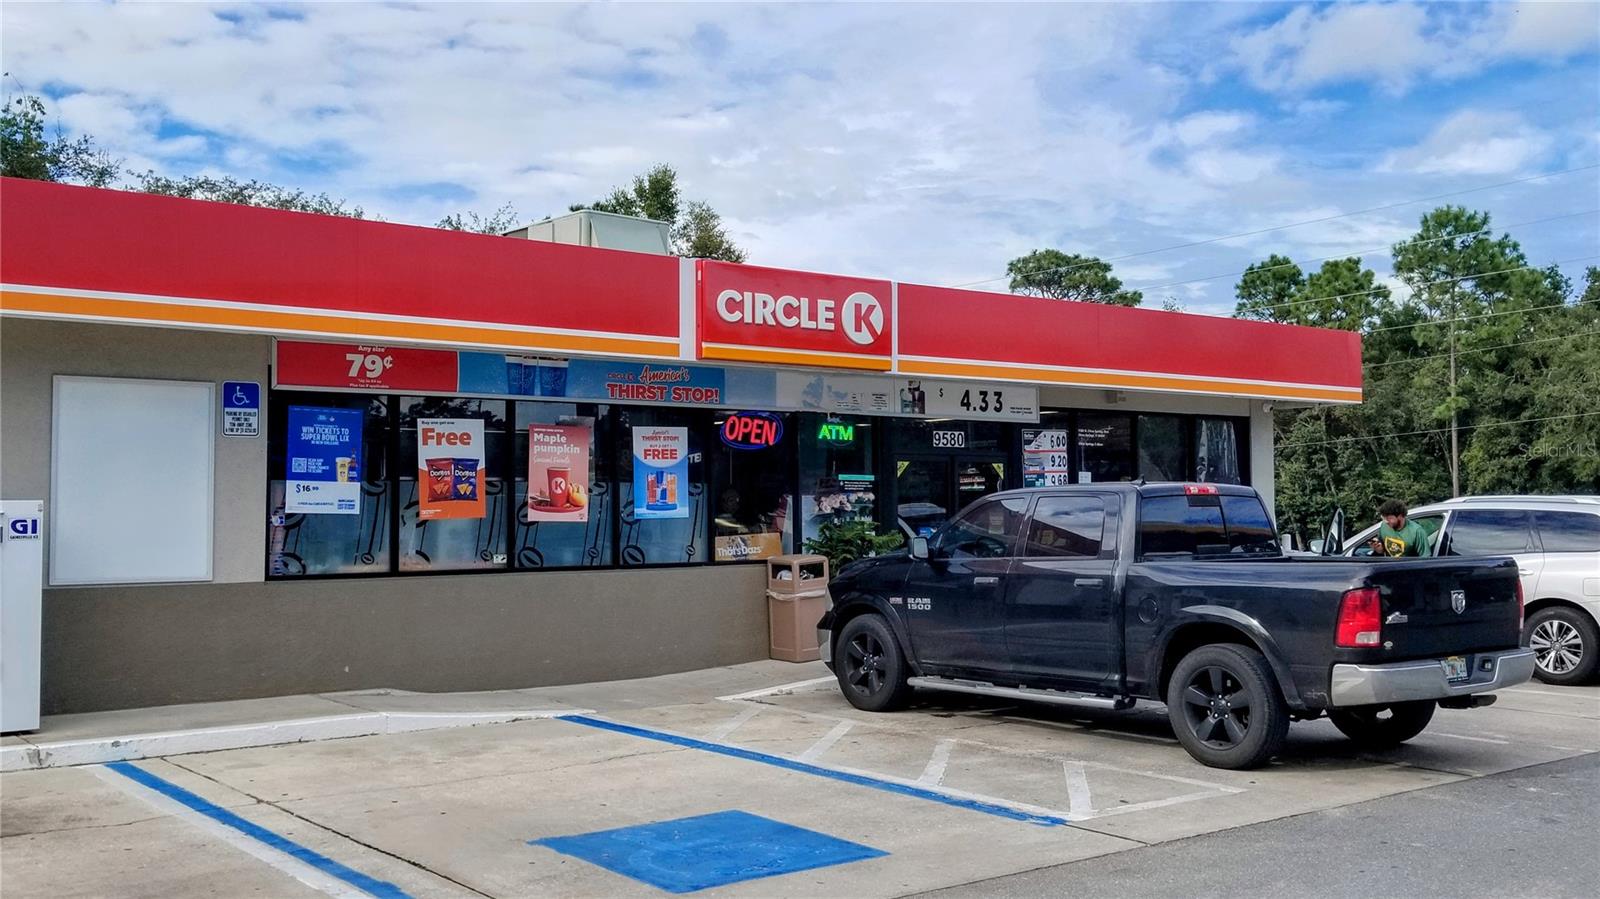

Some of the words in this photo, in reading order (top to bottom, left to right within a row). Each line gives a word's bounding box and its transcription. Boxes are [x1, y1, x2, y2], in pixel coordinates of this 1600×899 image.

[716, 289, 835, 331] CIRCLE
[358, 345, 372, 353] Any
[346, 353, 393, 378] 79¢
[639, 365, 690, 384] America's
[607, 383, 668, 402] THIRST
[671, 385, 720, 404] STOP!
[939, 387, 944, 398] $
[960, 389, 1003, 413] 4.33
[315, 427, 341, 435] TICKETS
[421, 428, 472, 446] Free
[725, 415, 776, 446] OPEN
[818, 424, 854, 441] ATM
[533, 433, 567, 445] Maple
[933, 432, 964, 446] 9580
[533, 444, 580, 455] pumpkin
[643, 448, 678, 460] FREE
[1050, 455, 1067, 468] 9.20
[10, 519, 38, 534] GI
